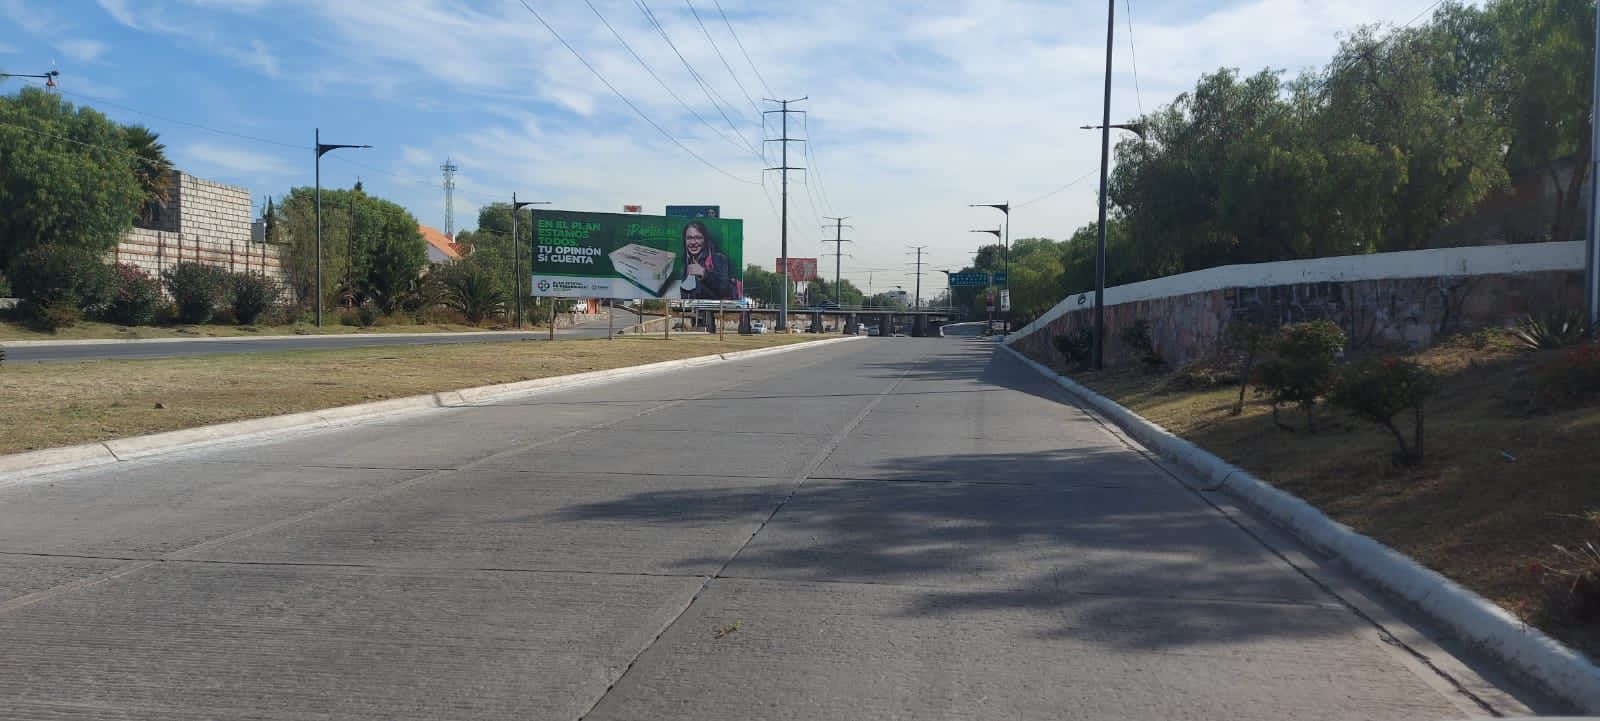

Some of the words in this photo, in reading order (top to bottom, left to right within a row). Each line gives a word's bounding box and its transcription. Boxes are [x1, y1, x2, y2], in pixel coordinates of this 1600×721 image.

[539, 219, 552, 228] EN
[572, 221, 600, 231] PLAN
[539, 228, 589, 238] ESTAMOS
[537, 245, 552, 253] TU
[555, 246, 601, 256] OPINIÓN
[551, 254, 594, 264] CUENTA
